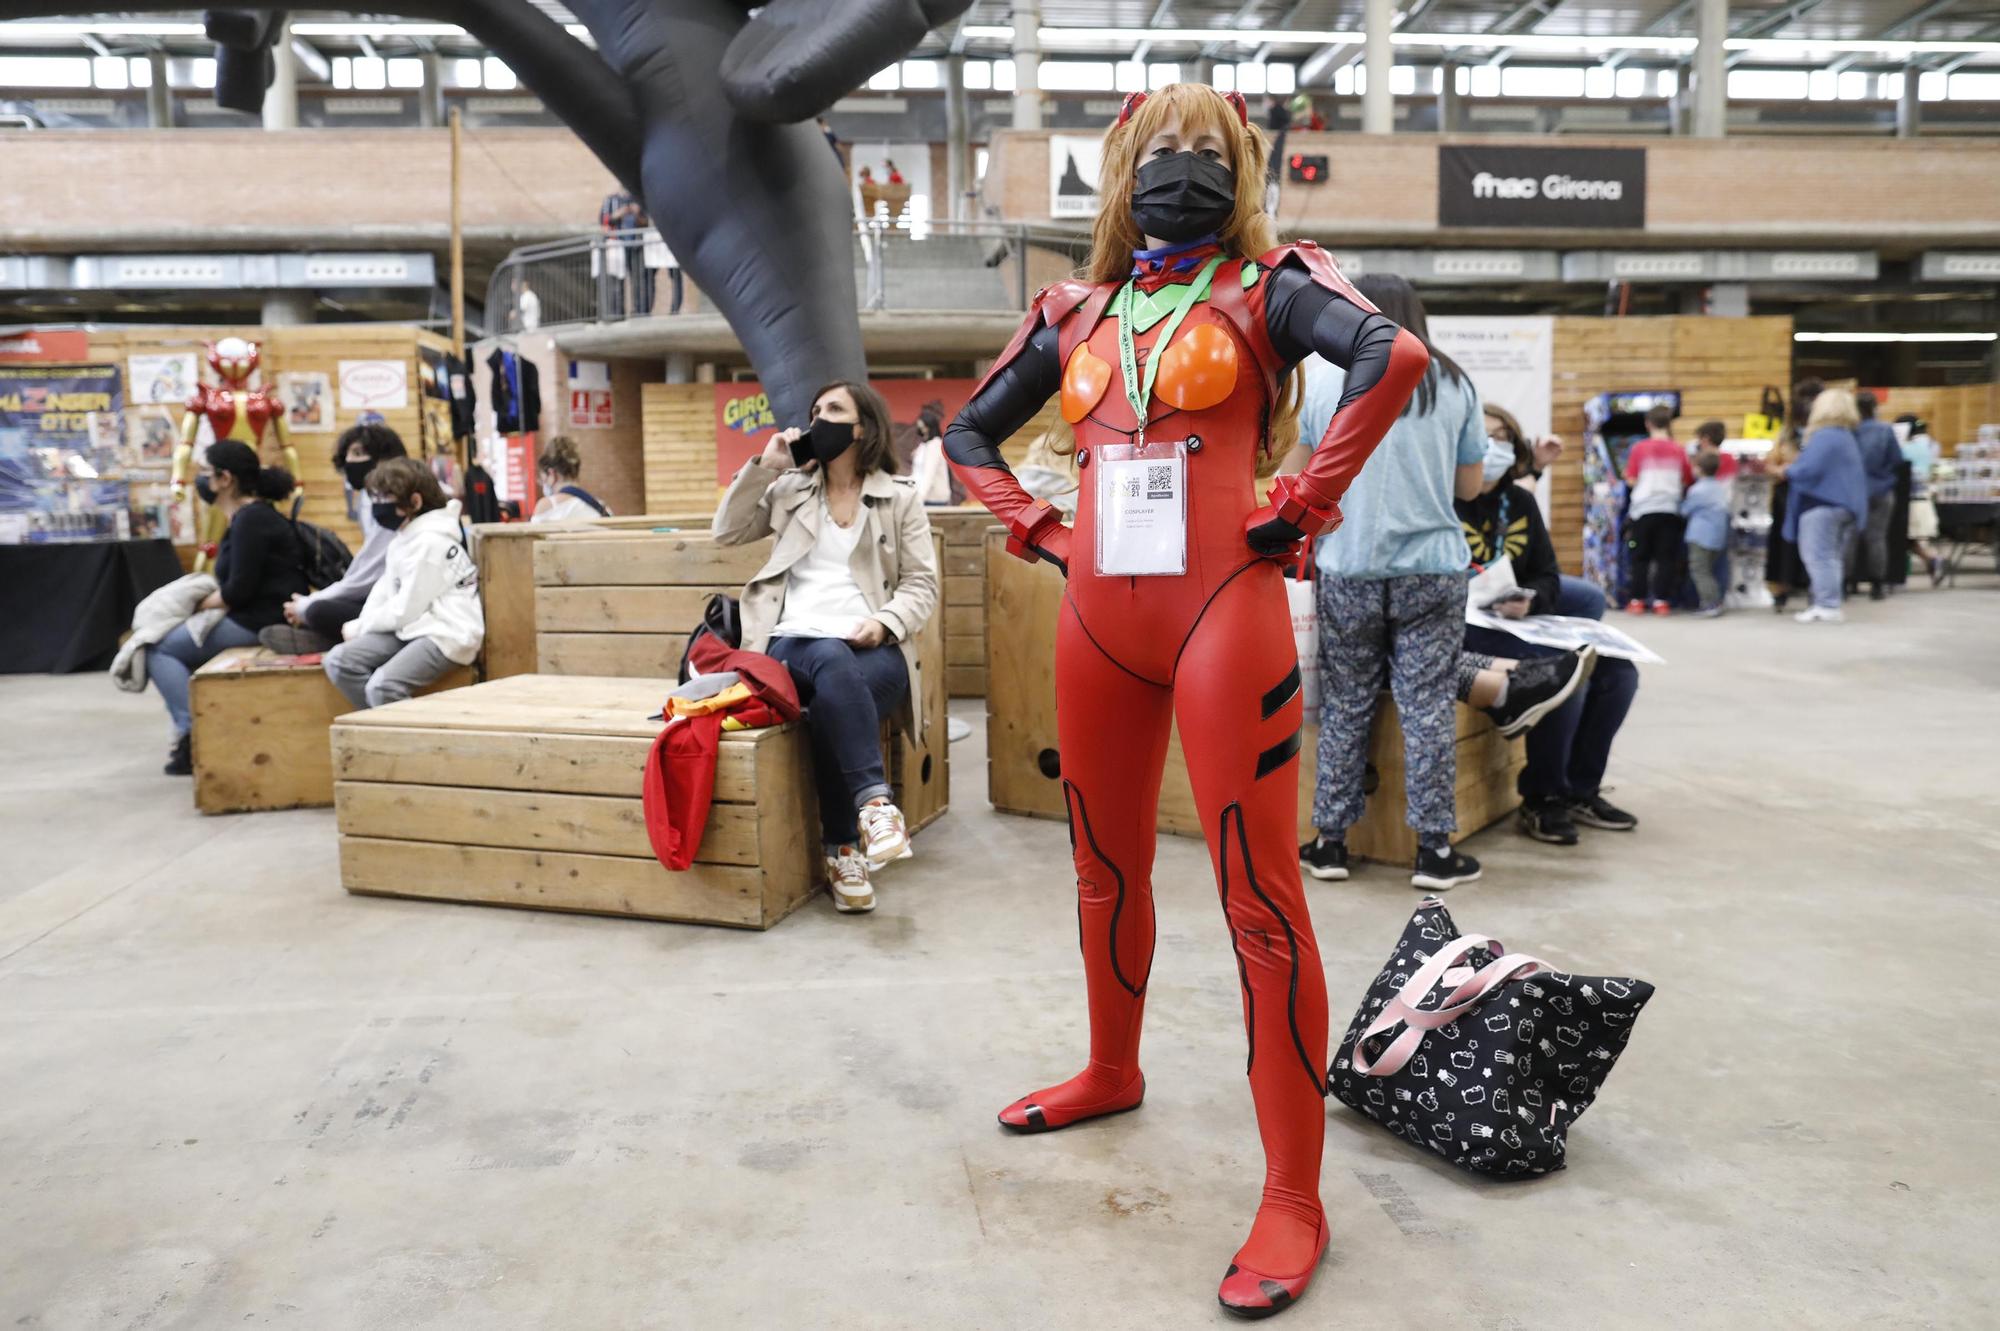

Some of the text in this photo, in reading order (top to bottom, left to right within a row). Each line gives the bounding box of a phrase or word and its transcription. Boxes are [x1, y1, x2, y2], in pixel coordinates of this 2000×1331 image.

[1472, 172, 1623, 200] fnac Girona
[41, 412, 88, 431] OTO
[723, 392, 769, 427] GIRO
